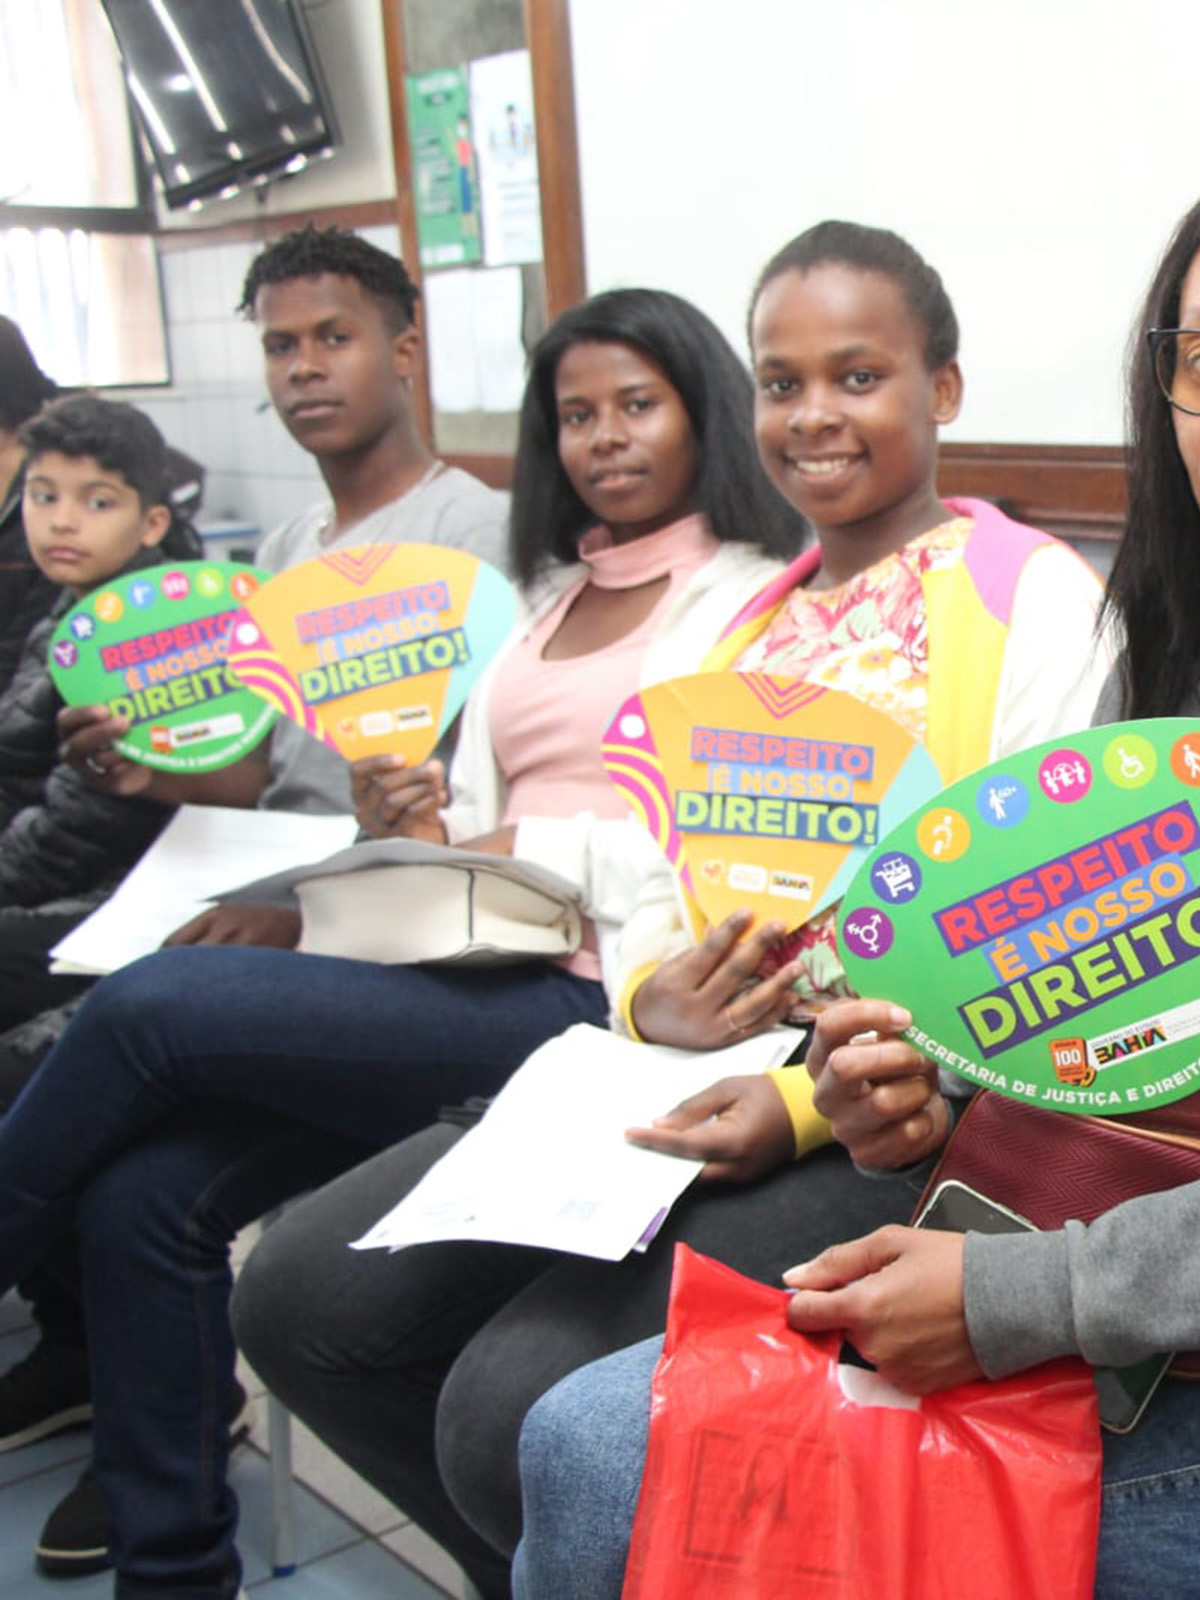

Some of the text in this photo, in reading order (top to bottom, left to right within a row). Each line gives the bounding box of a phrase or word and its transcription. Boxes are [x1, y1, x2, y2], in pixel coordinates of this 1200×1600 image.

[299, 584, 445, 639] RESPEITO
[343, 612, 435, 654] NOSSO
[301, 631, 469, 701] DIREITO!
[695, 730, 870, 776] RESPEITO
[741, 769, 851, 799] NOSSO
[676, 791, 877, 845] DIREITO!
[940, 810, 1196, 951] RESPEITO
[990, 861, 1186, 983] É NOSSO
[905, 1025, 1007, 1088] SECRETARIA
[1012, 1080, 1037, 1097] DE
[1041, 1088, 1121, 1105] JUSTIÇA
[1126, 1087, 1140, 1102] E
[1054, 1050, 1081, 1066] 100
